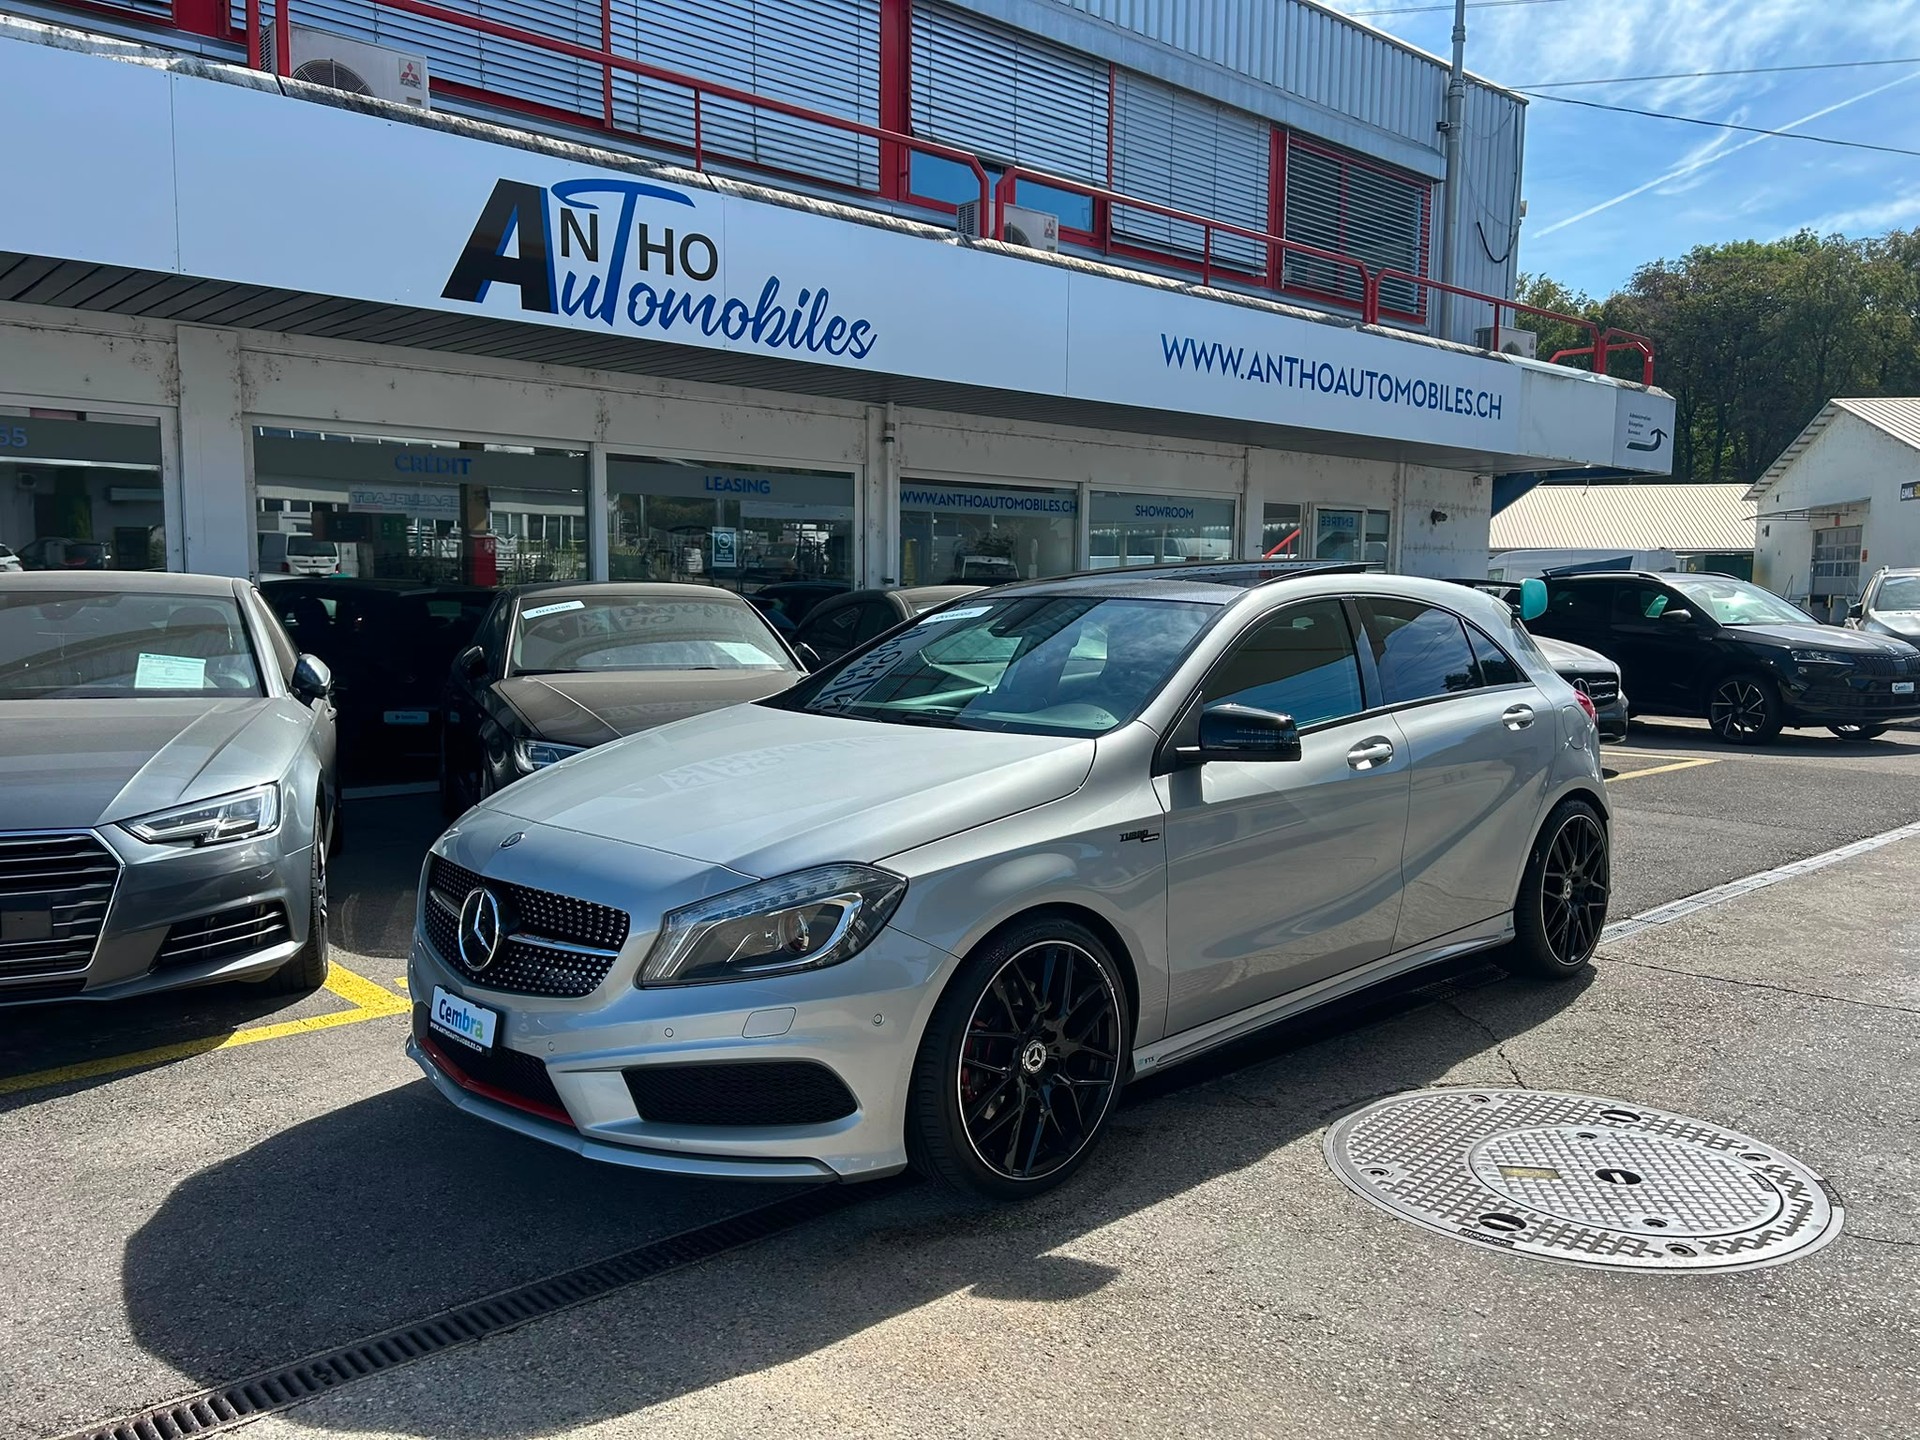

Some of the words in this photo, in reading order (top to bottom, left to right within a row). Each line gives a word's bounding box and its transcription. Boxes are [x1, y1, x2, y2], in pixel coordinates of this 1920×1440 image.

[1161, 334, 1502, 420] WWW.ANTHOAUTOMOBILES.CH
[394, 453, 472, 475] CRÉDIT
[705, 475, 770, 495] LEASING
[900, 490, 1077, 513] WWW.ANTHOAUTOMOBILES.CH
[1135, 504, 1195, 519] SHOWROOM
[439, 999, 482, 1039] Cembra
